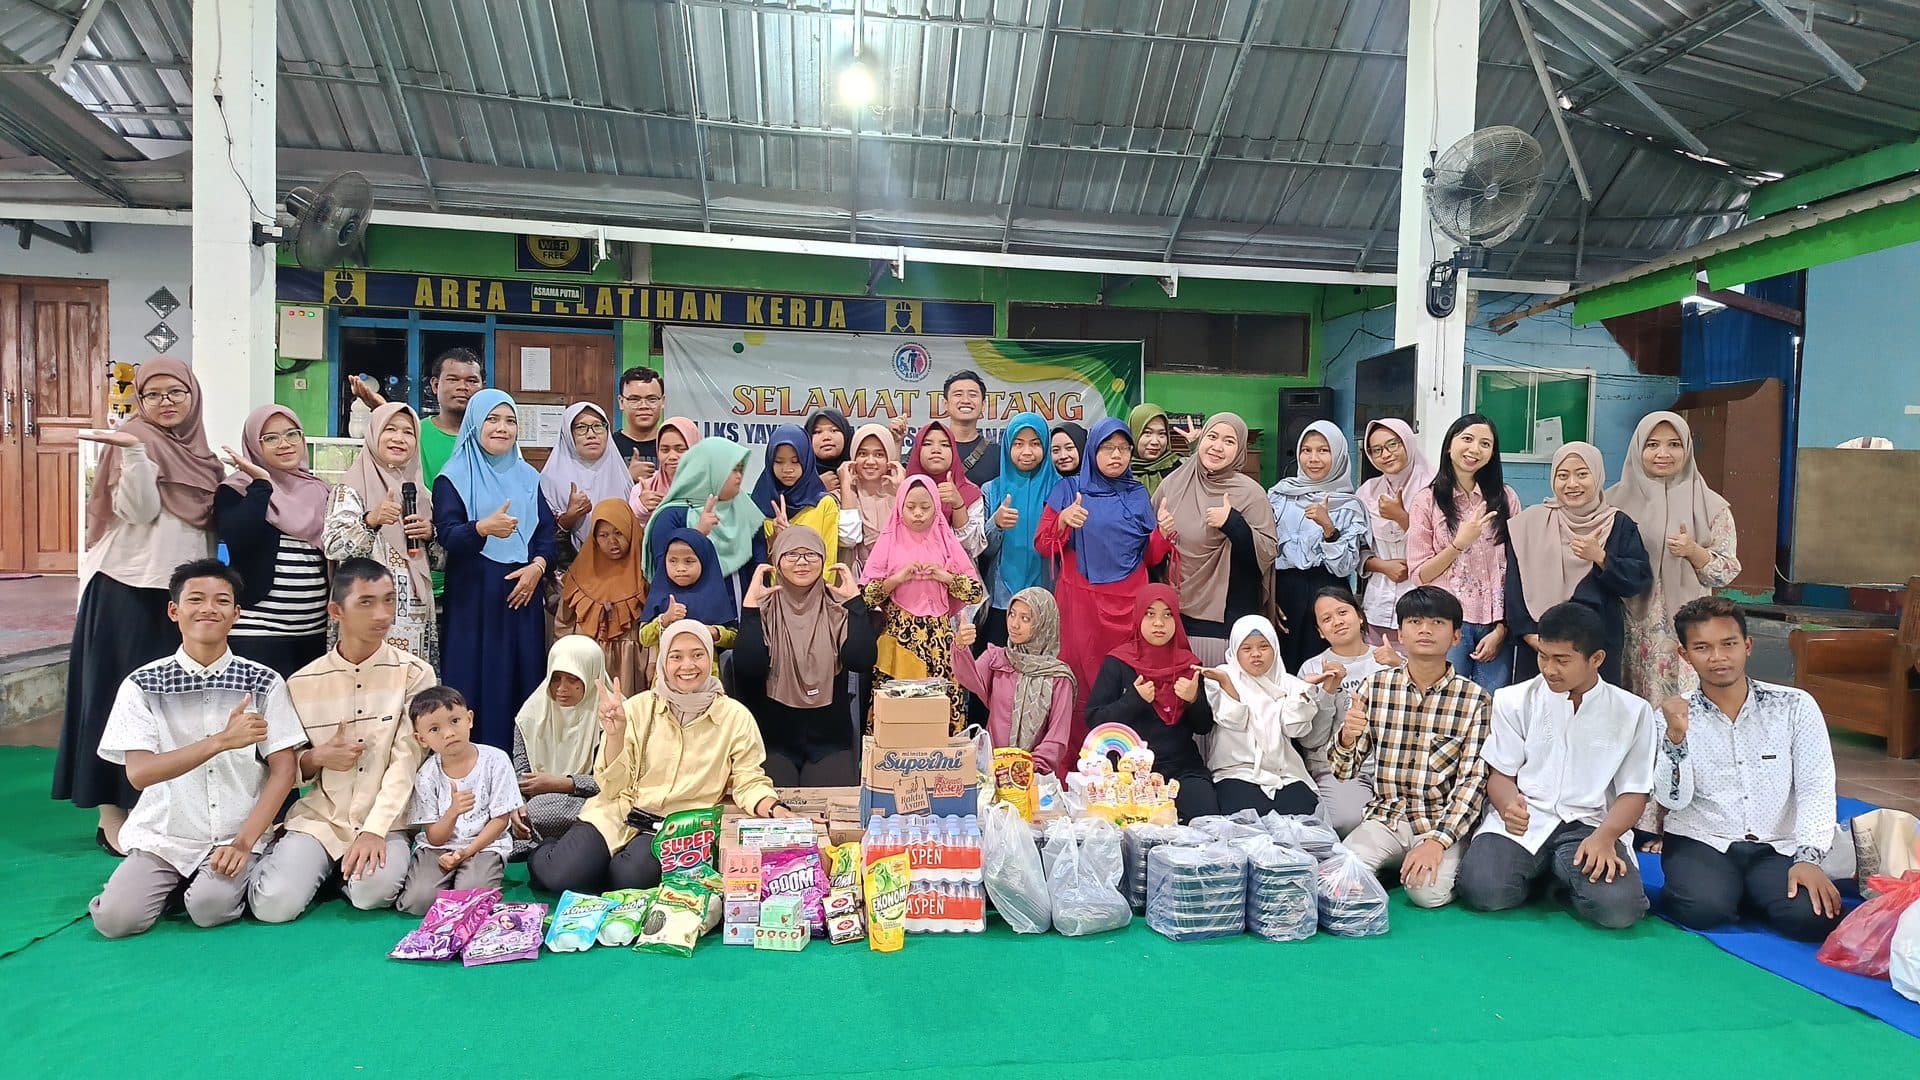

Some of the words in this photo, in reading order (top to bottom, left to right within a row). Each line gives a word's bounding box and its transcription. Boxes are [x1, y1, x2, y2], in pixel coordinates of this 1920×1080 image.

[543, 252, 565, 260] FREE
[415, 277, 506, 311] AREA
[746, 295, 846, 329] KERJA
[533, 286, 559, 297] ASRAMA
[559, 288, 580, 299] PUTRA
[732, 385, 919, 418] SELAMAT
[928, 391, 1083, 422] DTANG
[661, 830, 715, 857] SUPER
[768, 866, 816, 896] BOOM
[906, 897, 945, 916] ASPEN
